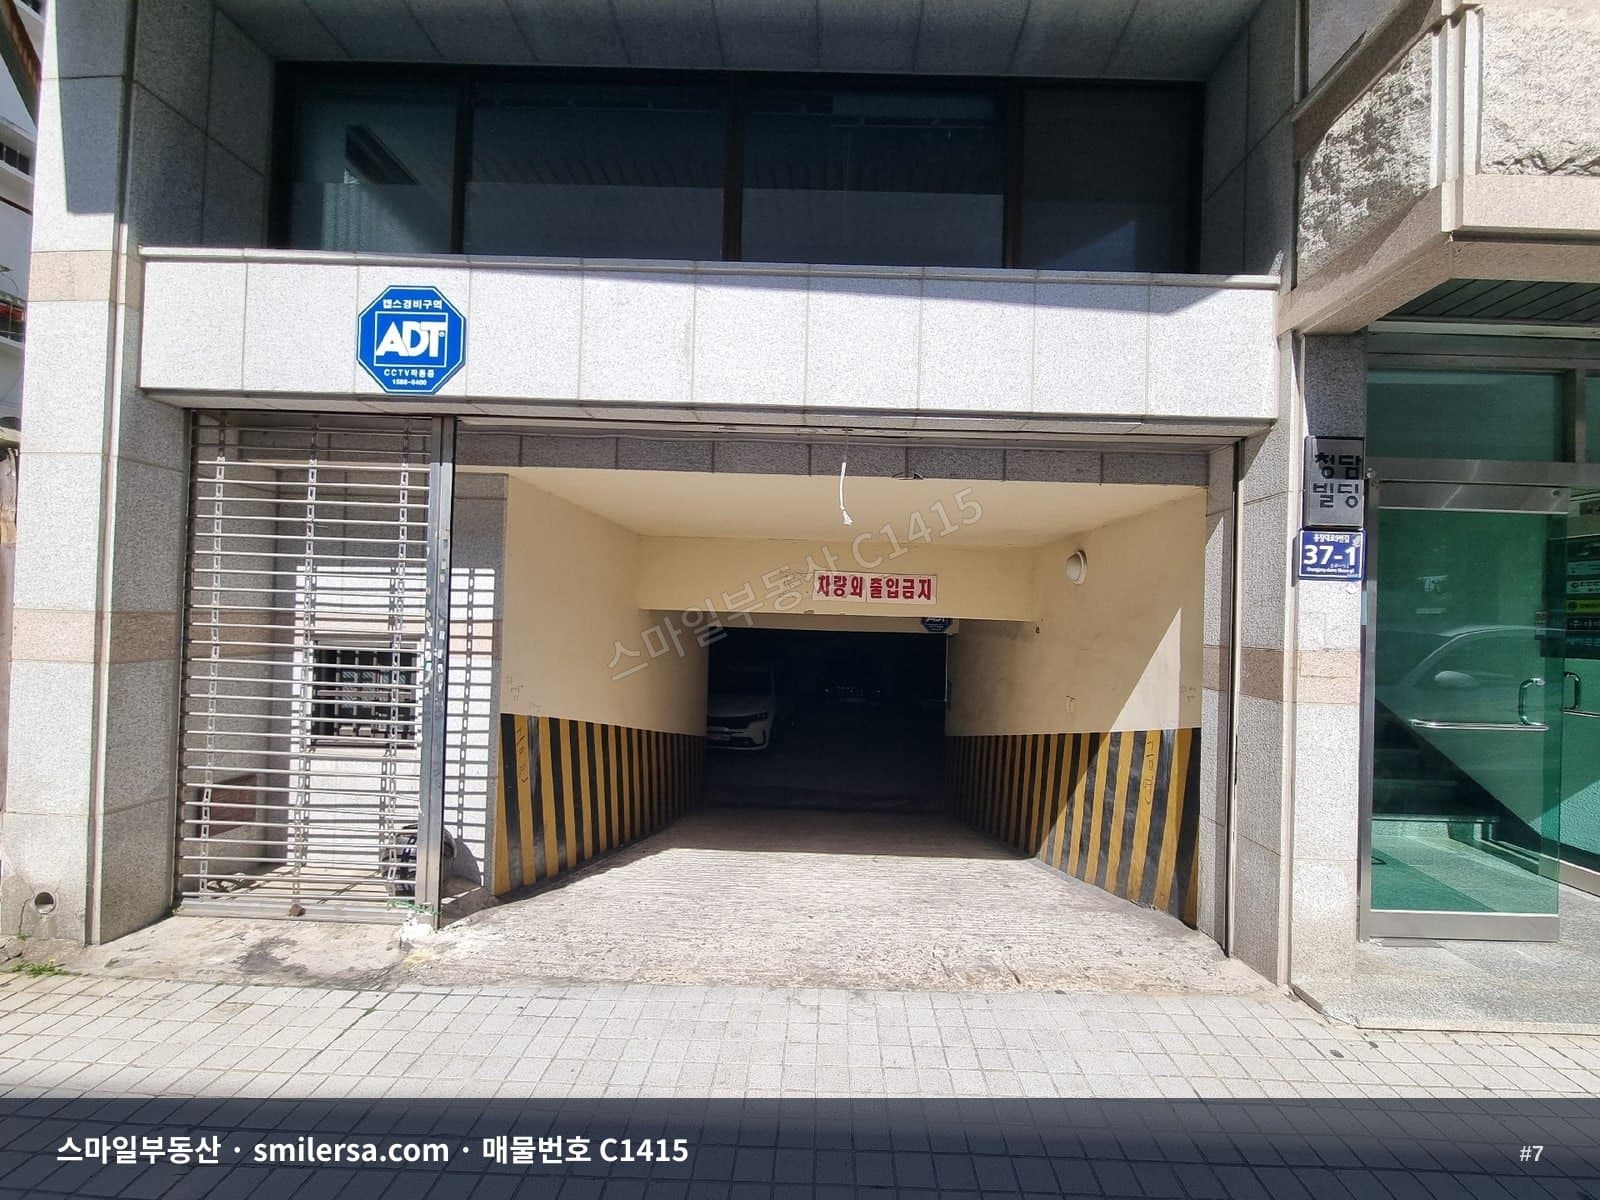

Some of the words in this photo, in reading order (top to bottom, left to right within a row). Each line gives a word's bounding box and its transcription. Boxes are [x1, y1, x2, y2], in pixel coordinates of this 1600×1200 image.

[375, 320, 447, 358] ADT
[1314, 452, 1362, 480] 청담
[1312, 482, 1359, 509] 빌딩
[1303, 544, 1356, 566] 37-1
[816, 575, 863, 598] 차량외
[869, 577, 932, 600] 출입금지
